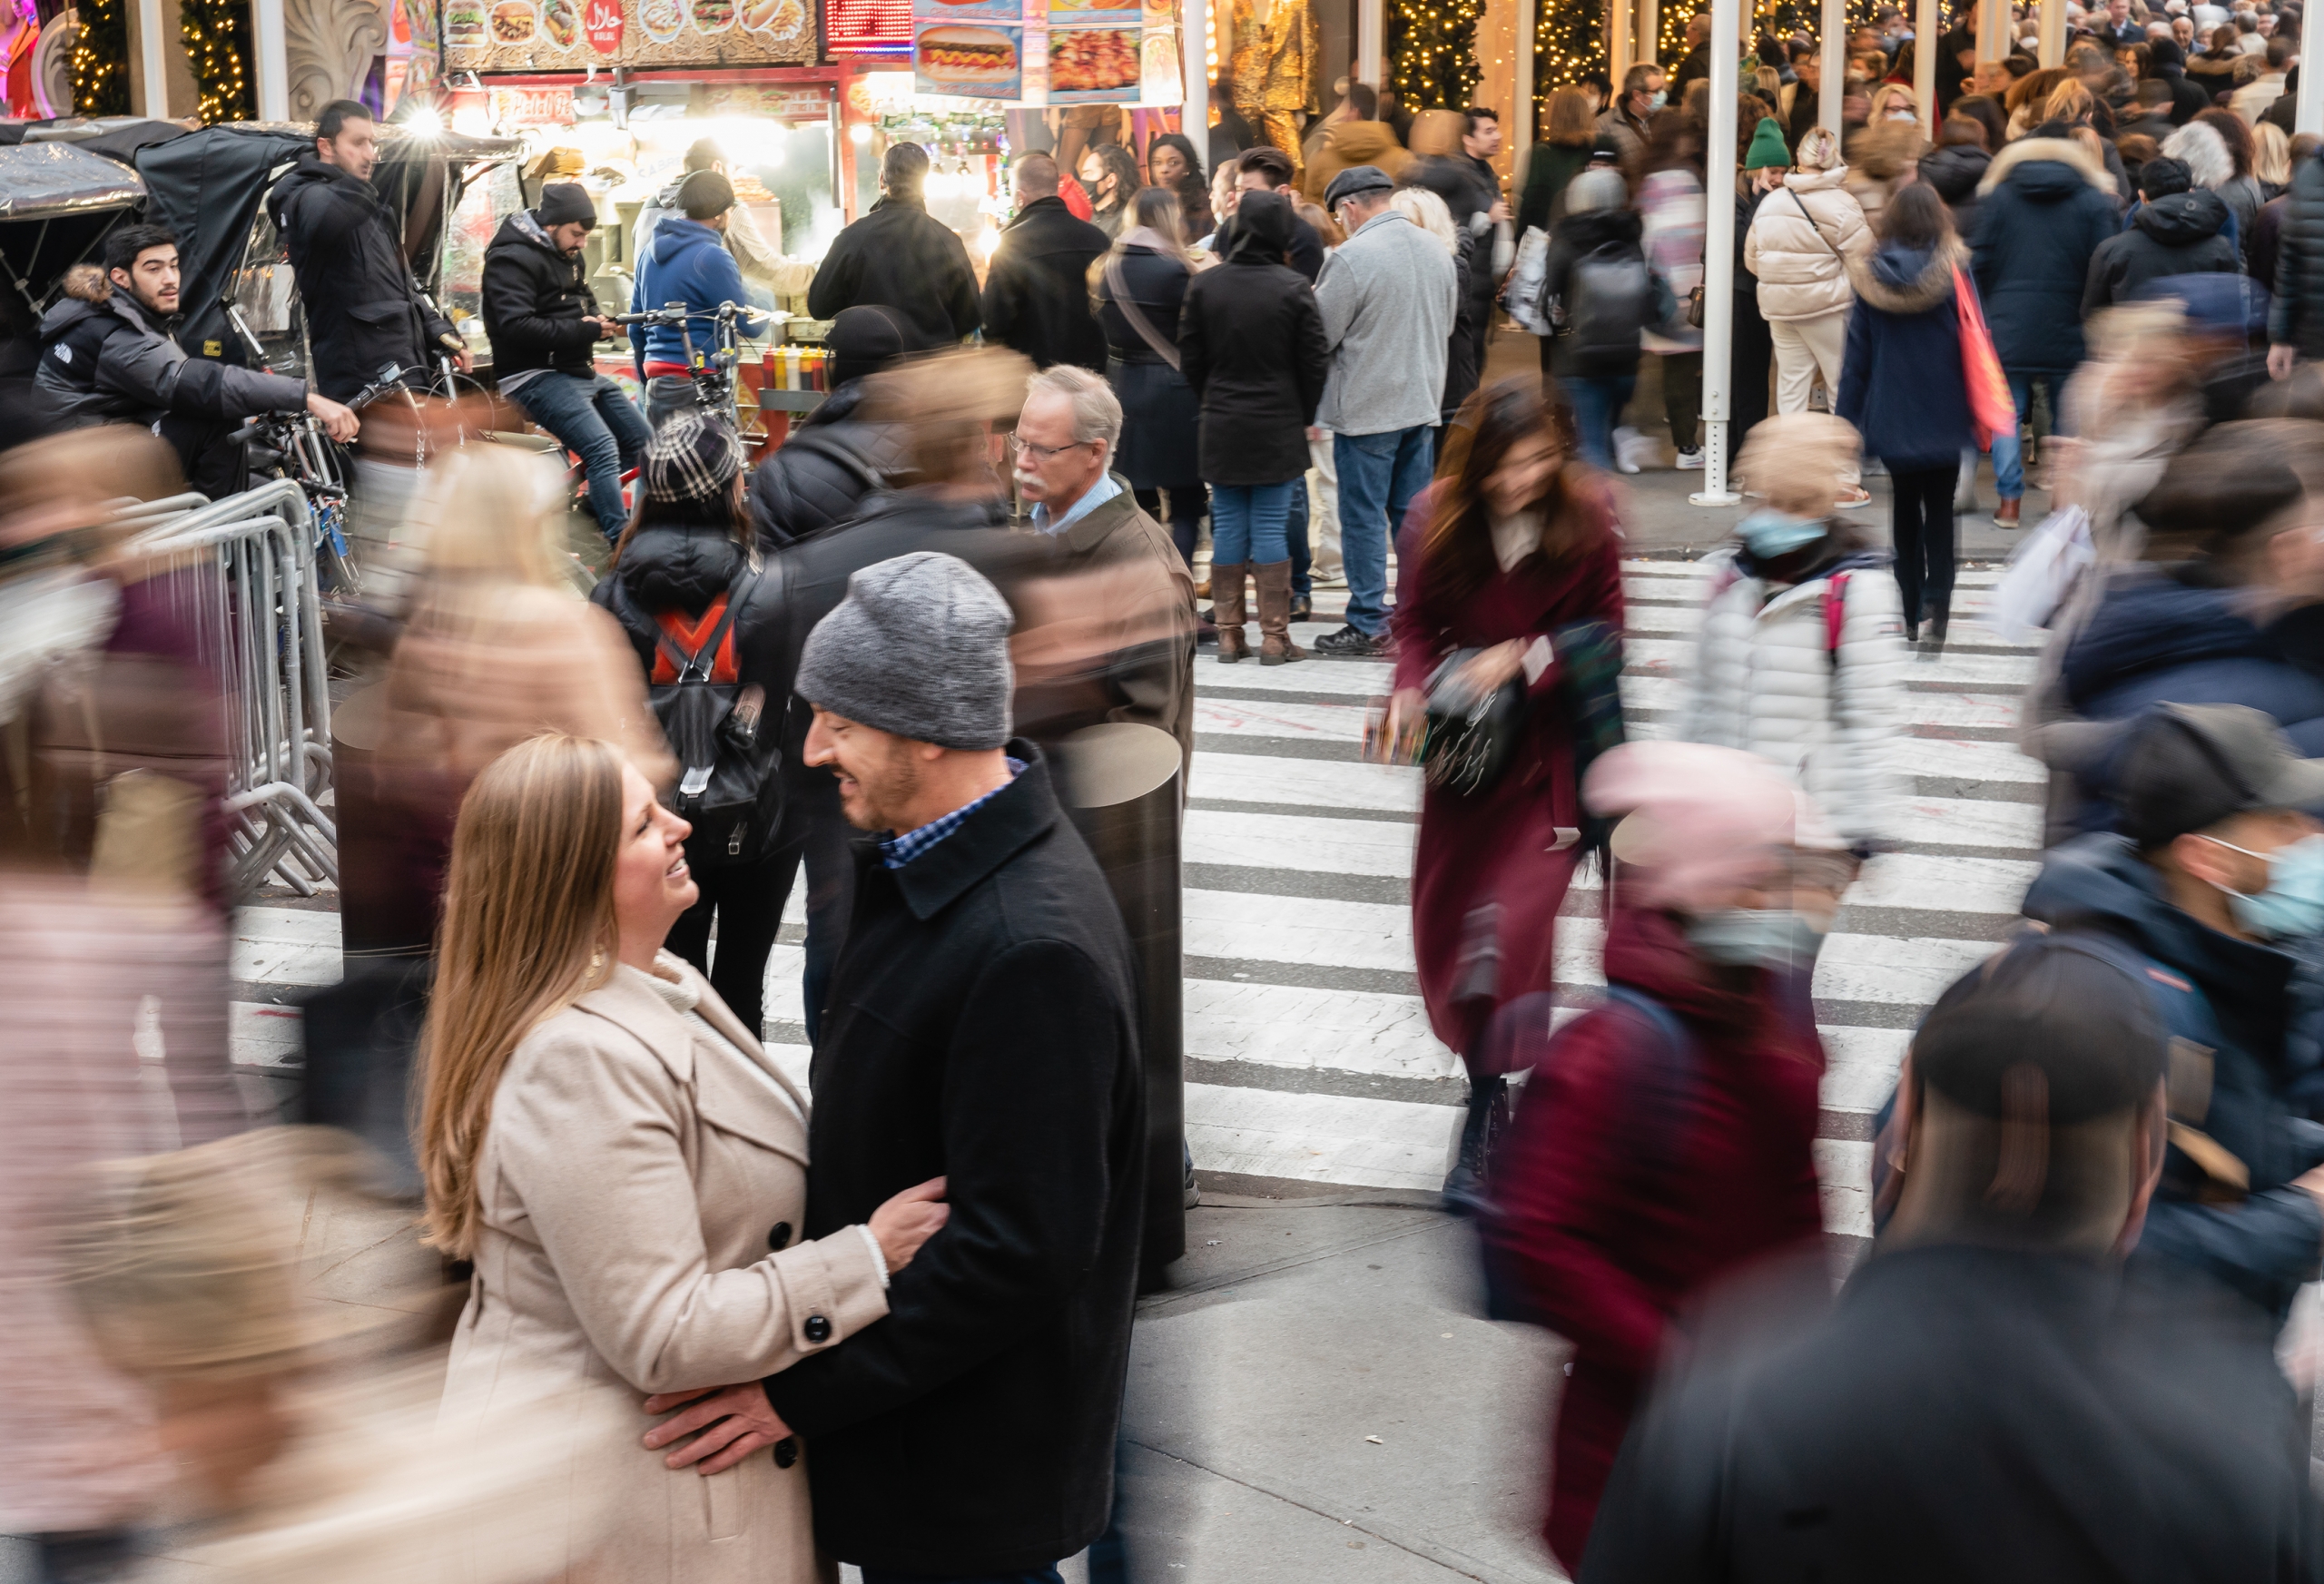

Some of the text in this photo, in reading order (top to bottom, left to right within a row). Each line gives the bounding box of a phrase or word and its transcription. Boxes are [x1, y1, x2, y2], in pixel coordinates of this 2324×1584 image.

[586, 1, 624, 31] حلال
[594, 31, 616, 41] HALAL
[512, 94, 552, 115] Halal
